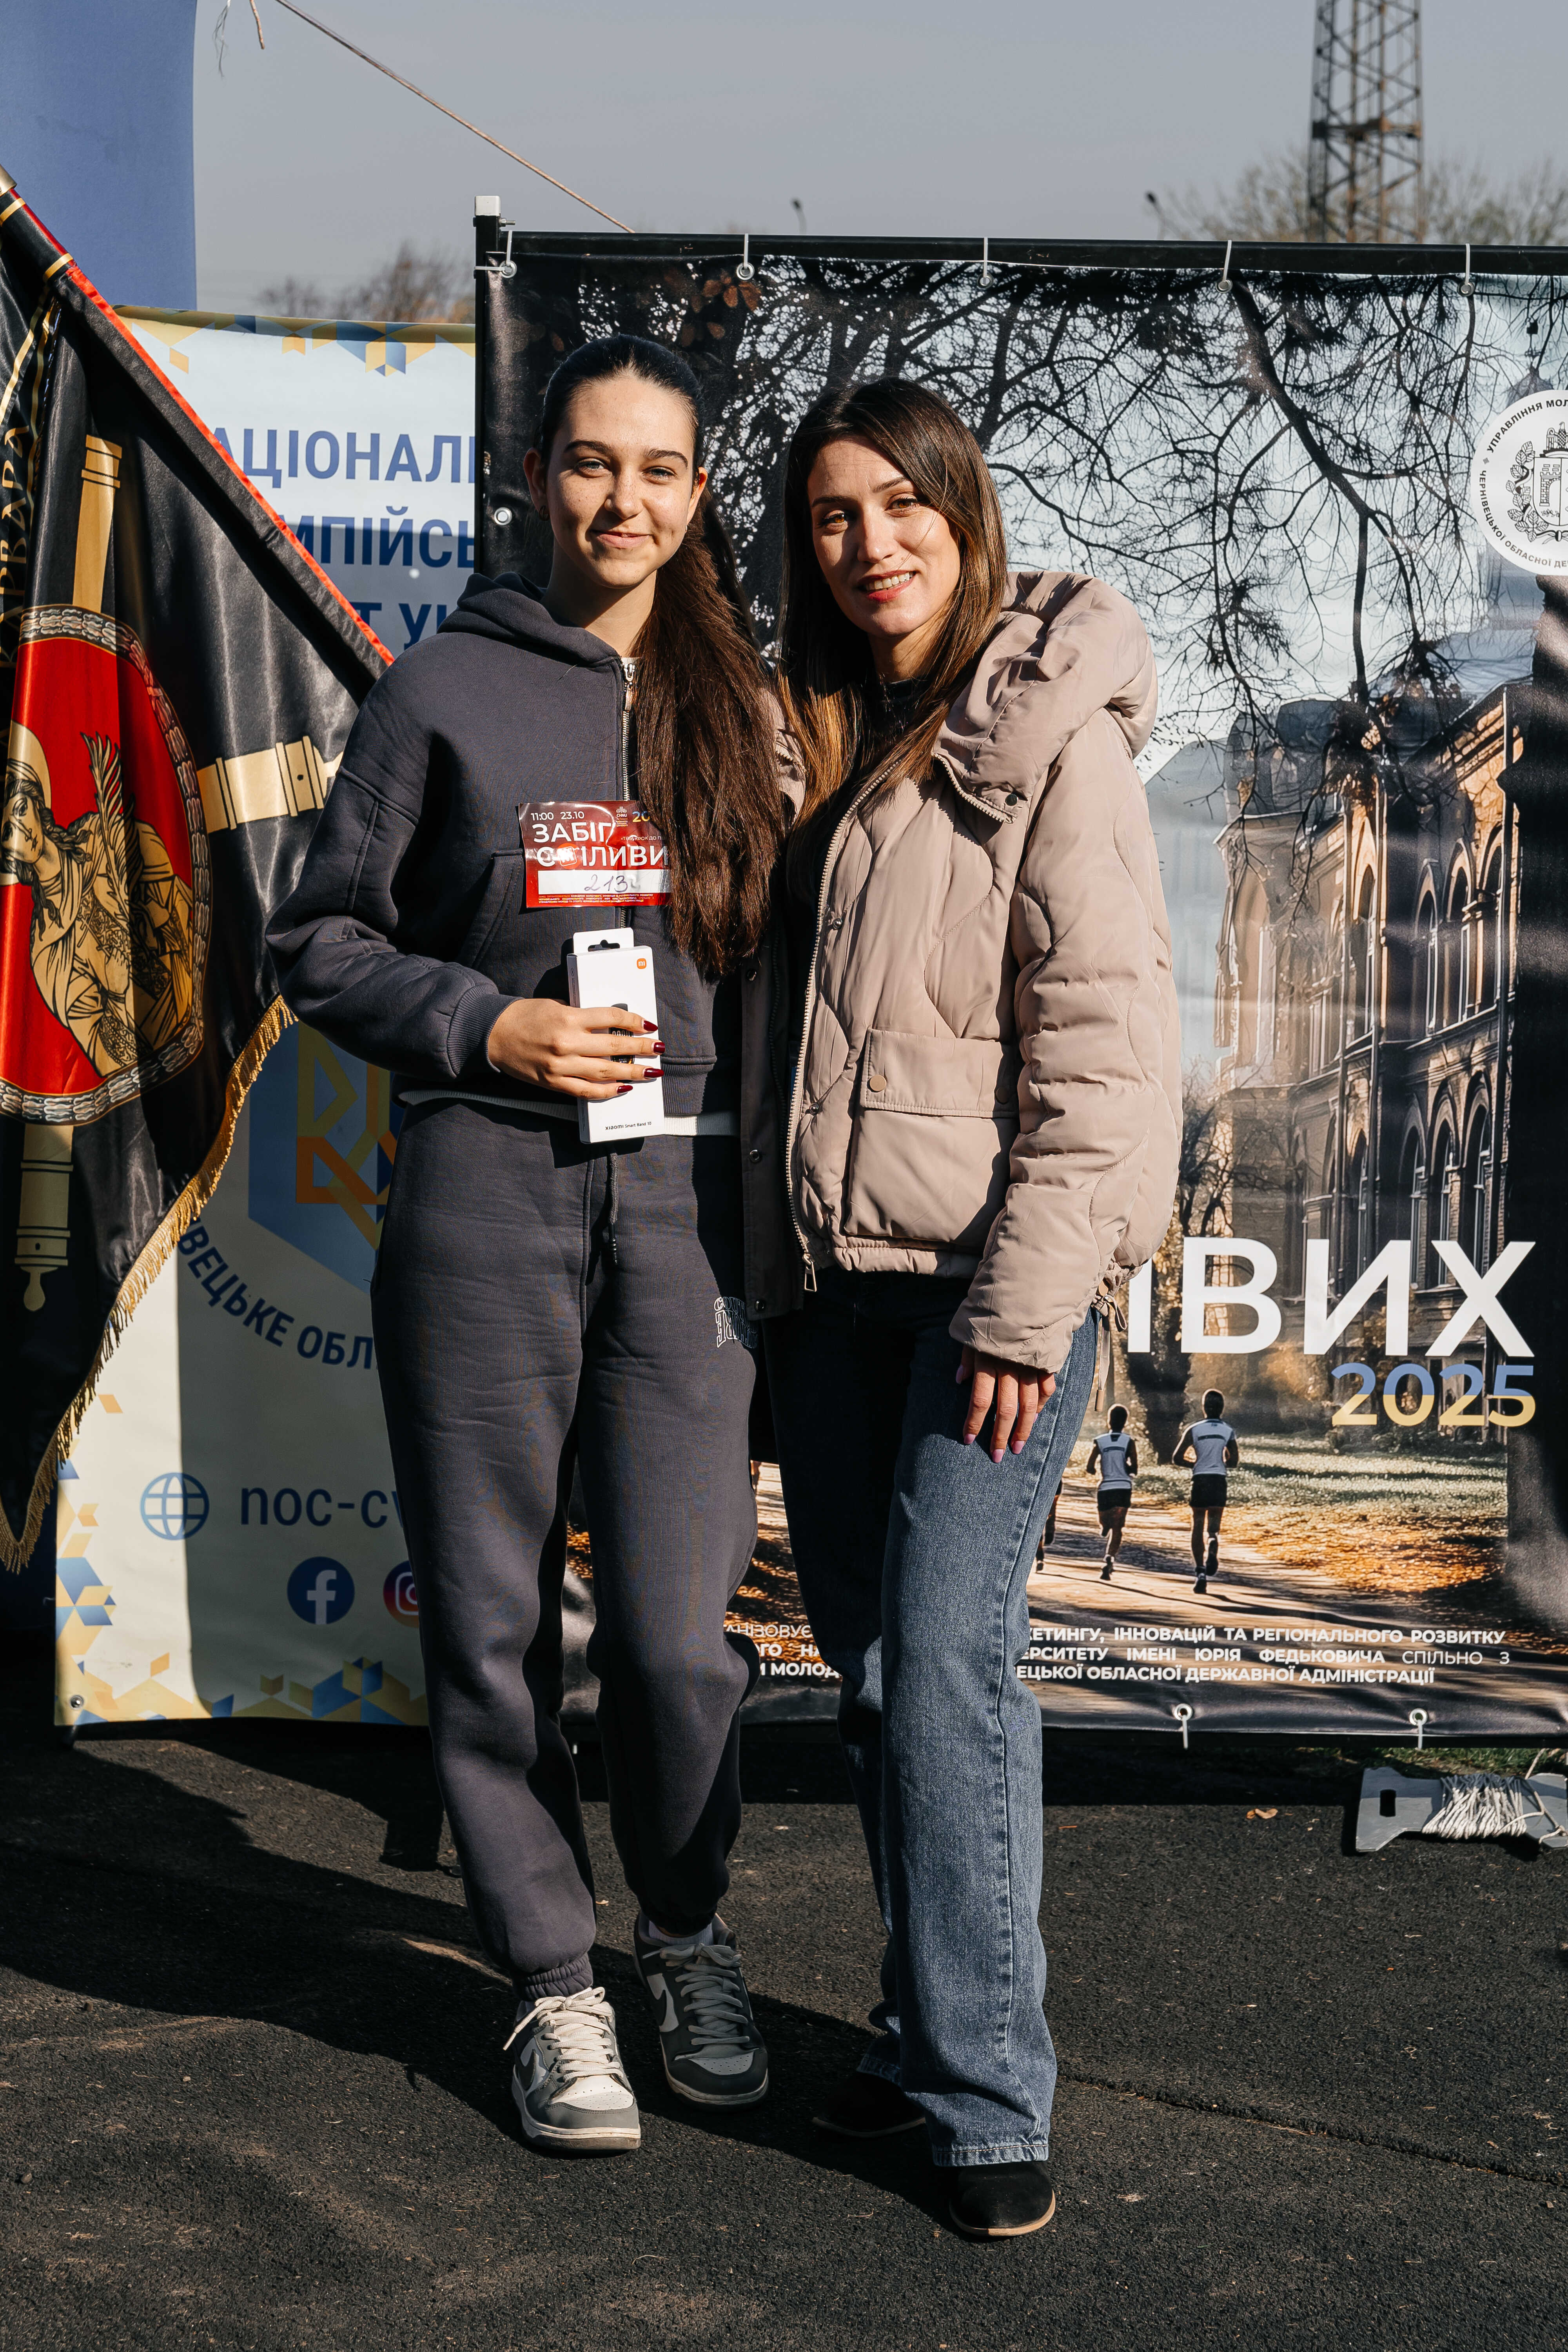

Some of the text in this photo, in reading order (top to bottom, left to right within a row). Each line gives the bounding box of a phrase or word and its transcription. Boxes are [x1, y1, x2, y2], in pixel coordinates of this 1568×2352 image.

[1486, 402, 1543, 453] УПРАВЛІННЯ
[213, 427, 475, 488] ЦІОНАЛ
[1479, 470, 1568, 568] ЧЕРНІВЕЦЬКОЇ ОБЛАСНОЇ ДЕ
[530, 811, 584, 821] 11:00 23.10
[532, 822, 612, 843] ЗАБІГ
[296, 1325, 378, 1371] ОБЛ
[1330, 1361, 1537, 1427] 2025
[723, 1624, 1506, 1644] АНІЗОВУЄ ЕТИНГУ, ІННОВАЦІЙ ТА РЕГІОНАЛЬНОГО РОЗВИТКУ
[755, 1643, 782, 1657] ГО
[1127, 1647, 1176, 1662] ІМЕНІ
[1194, 1648, 1241, 1662] ЮРІЯ
[1259, 1648, 1386, 1665] ФЕДЬКОВИЧА
[1402, 1650, 1483, 1665] СПІЛЬНО
[1014, 1663, 1084, 1681] ЕЦЬКОЇ
[1086, 1664, 1181, 1681] ОБЛАСНОЇ
[1184, 1665, 1296, 1683] ДЕРЖАВНОЇ
[1298, 1666, 1436, 1686] АДМІНІСТРАЦІЇ
